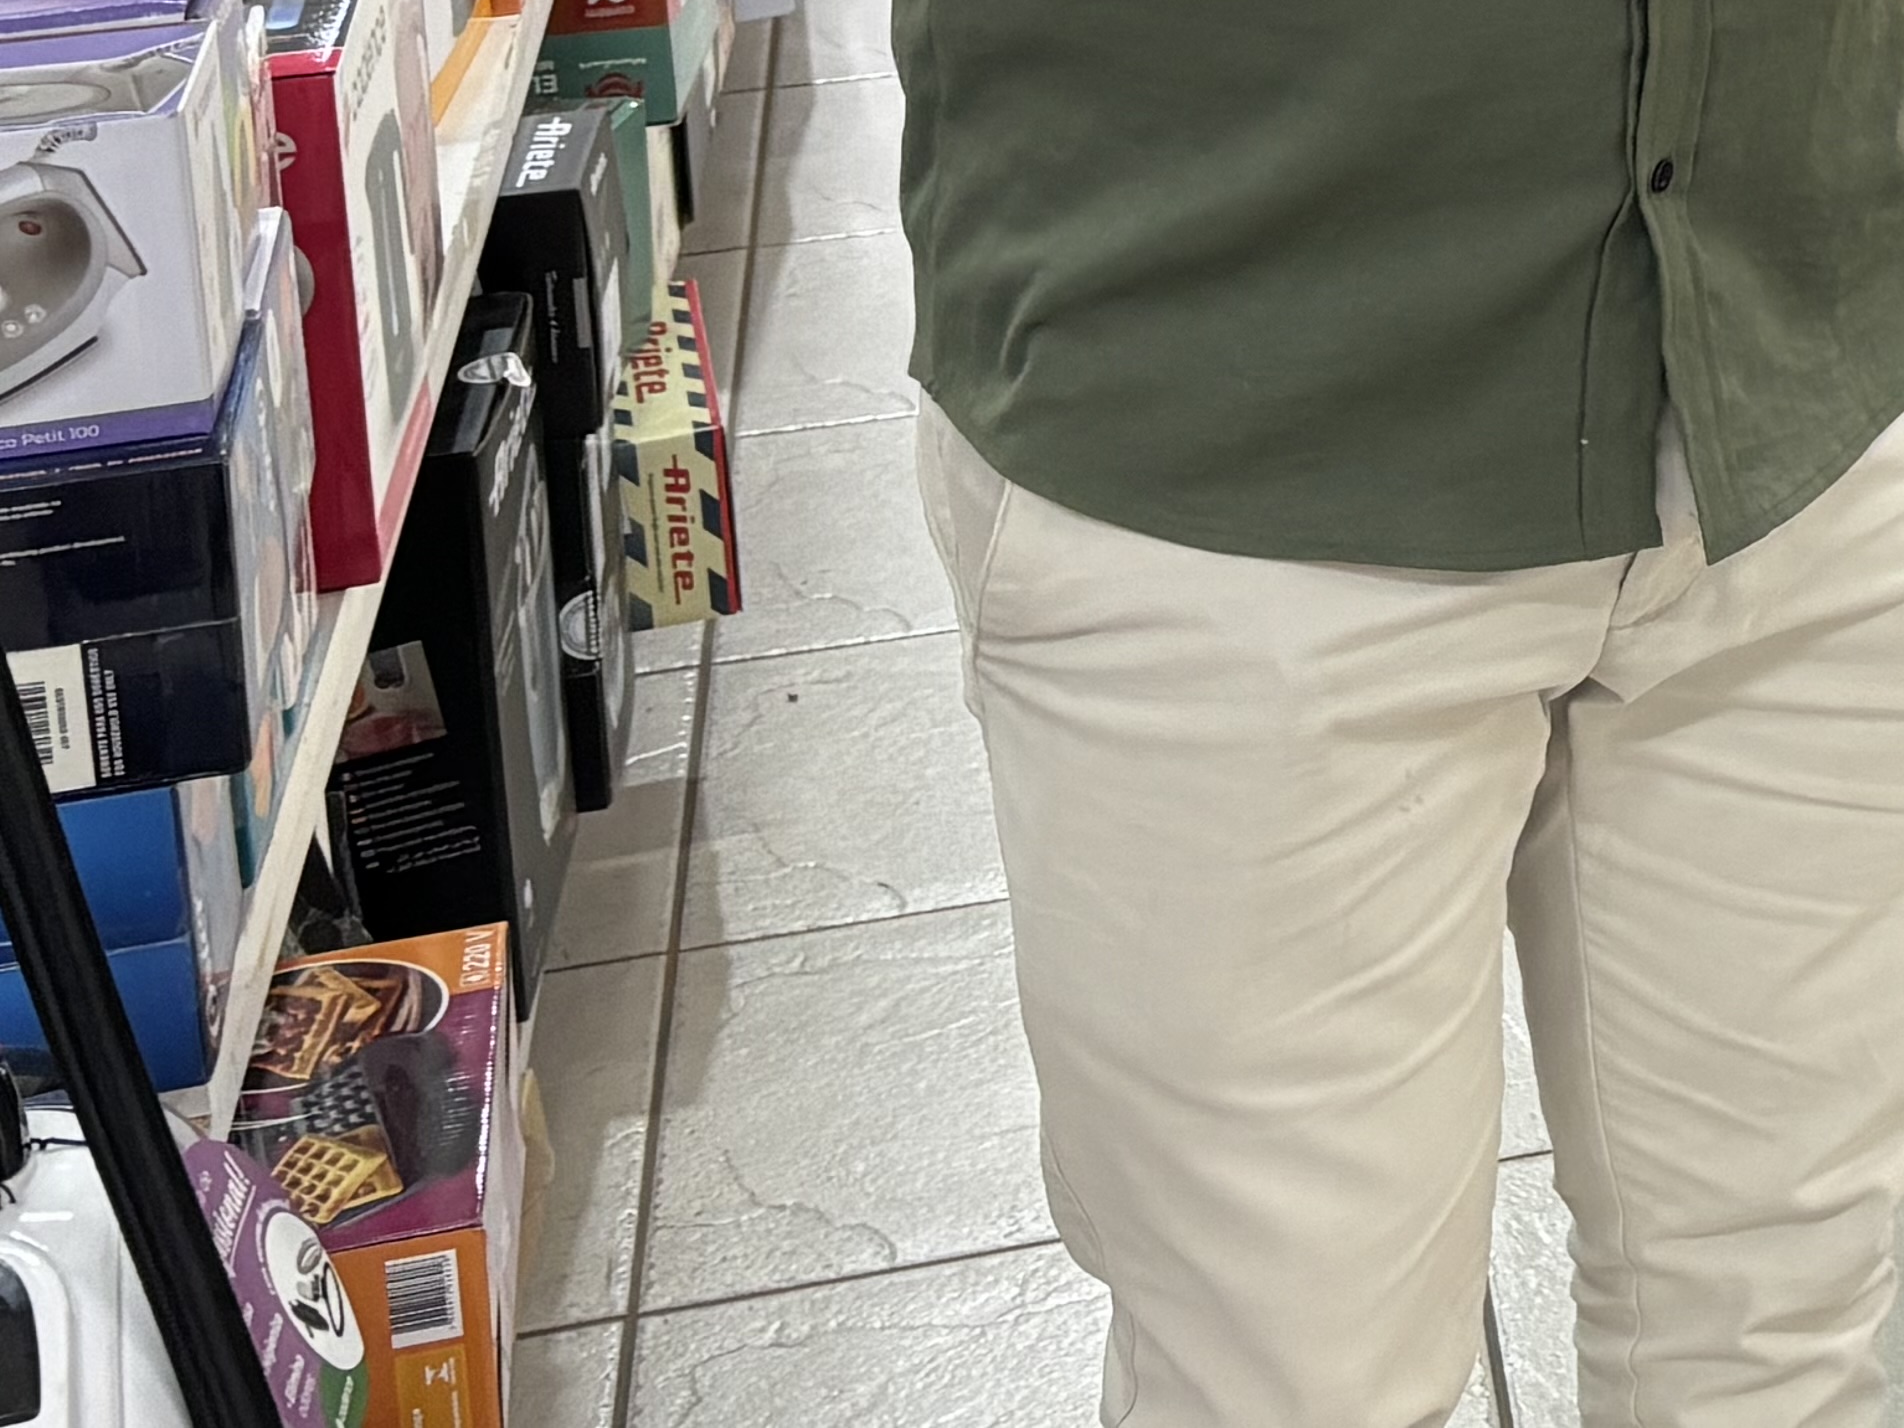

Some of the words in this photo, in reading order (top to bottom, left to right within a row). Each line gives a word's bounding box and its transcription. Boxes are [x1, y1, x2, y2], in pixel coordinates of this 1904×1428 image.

[515, 116, 573, 189] Ariete
[21, 428, 65, 447] Petit
[70, 423, 100, 441] 100
[661, 453, 694, 606] Ariete
[462, 943, 491, 972] 220
